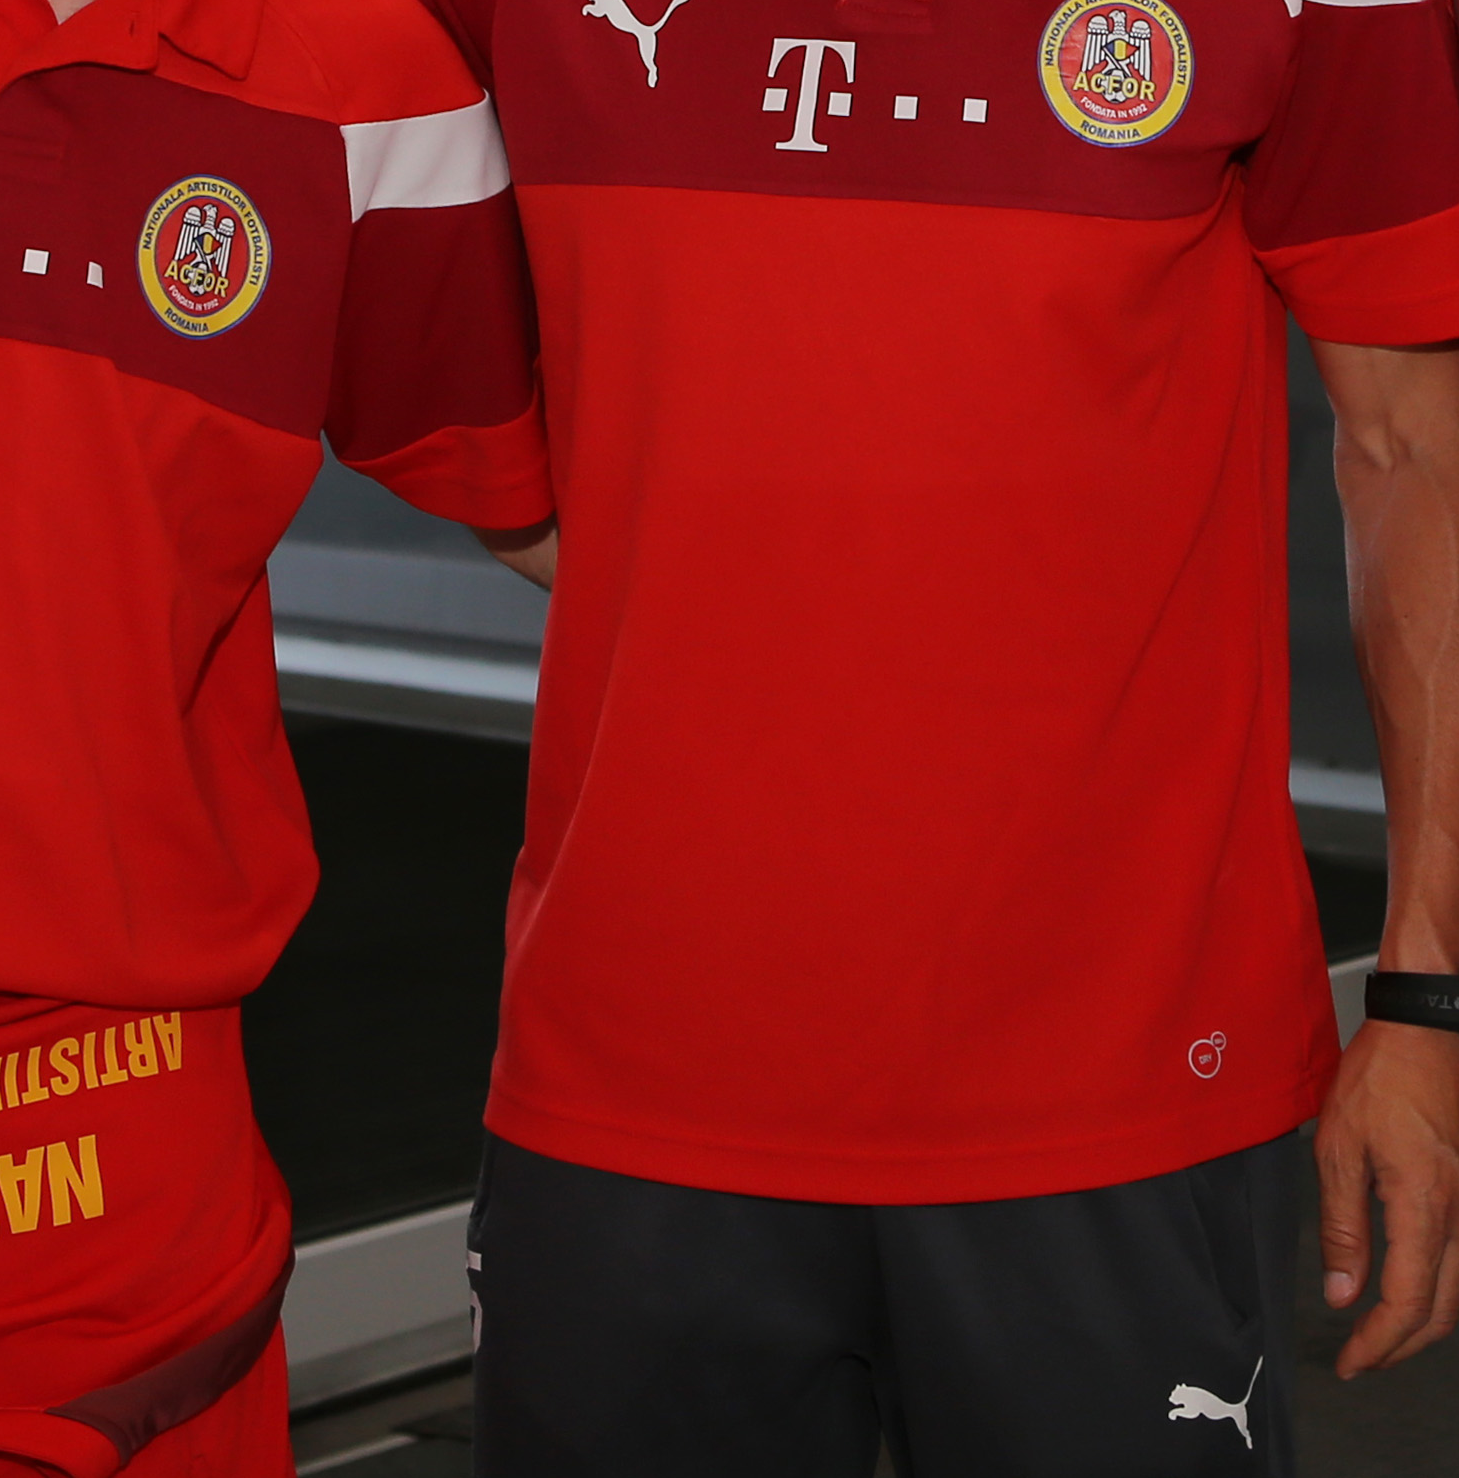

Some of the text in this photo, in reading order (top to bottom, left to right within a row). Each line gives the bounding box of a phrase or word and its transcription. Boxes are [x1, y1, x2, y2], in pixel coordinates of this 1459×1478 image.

[1045, 1, 1083, 66] NATIONALA
[1160, 10, 1187, 86] FOTBALISTI
[1072, 71, 1156, 102] ACFOR
[1080, 120, 1141, 139] ROMANIA
[1117, 110, 1128, 119] IN
[142, 181, 264, 286] NATIONALA ARTISTILOR FOTBALISTI
[164, 260, 229, 298] ACFOR
[164, 307, 209, 333] ROMANIA
